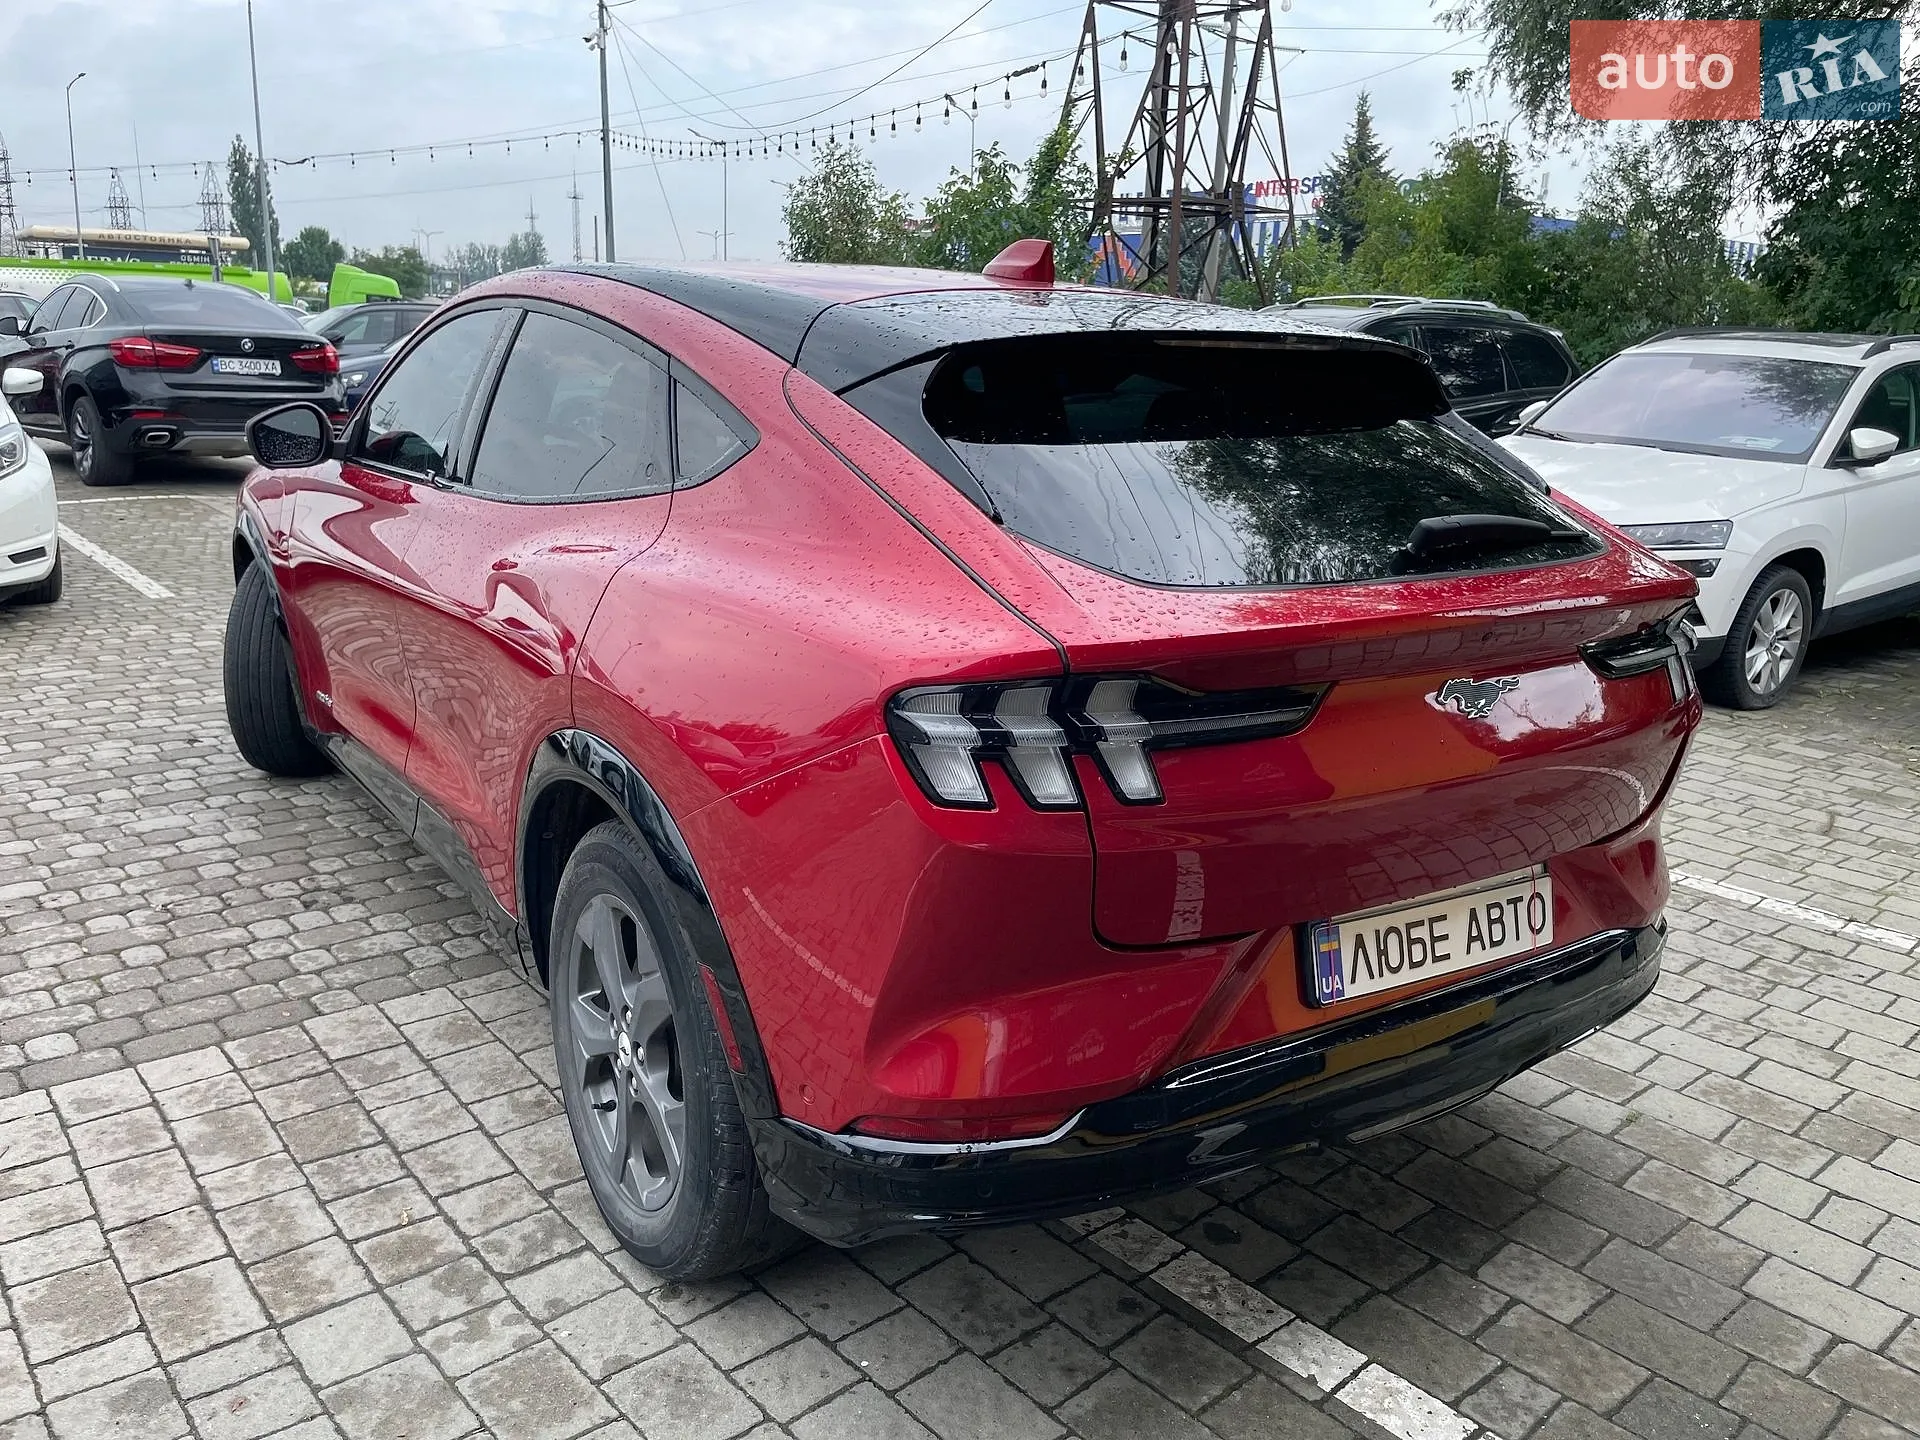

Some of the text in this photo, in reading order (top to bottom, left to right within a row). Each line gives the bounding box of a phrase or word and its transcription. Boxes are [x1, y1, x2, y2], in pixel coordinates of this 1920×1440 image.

[220, 359, 278, 372] BC 3400 XA
[1350, 891, 1547, 985] ЛЮБЕ АВТО
[1321, 977, 1343, 994] UA
